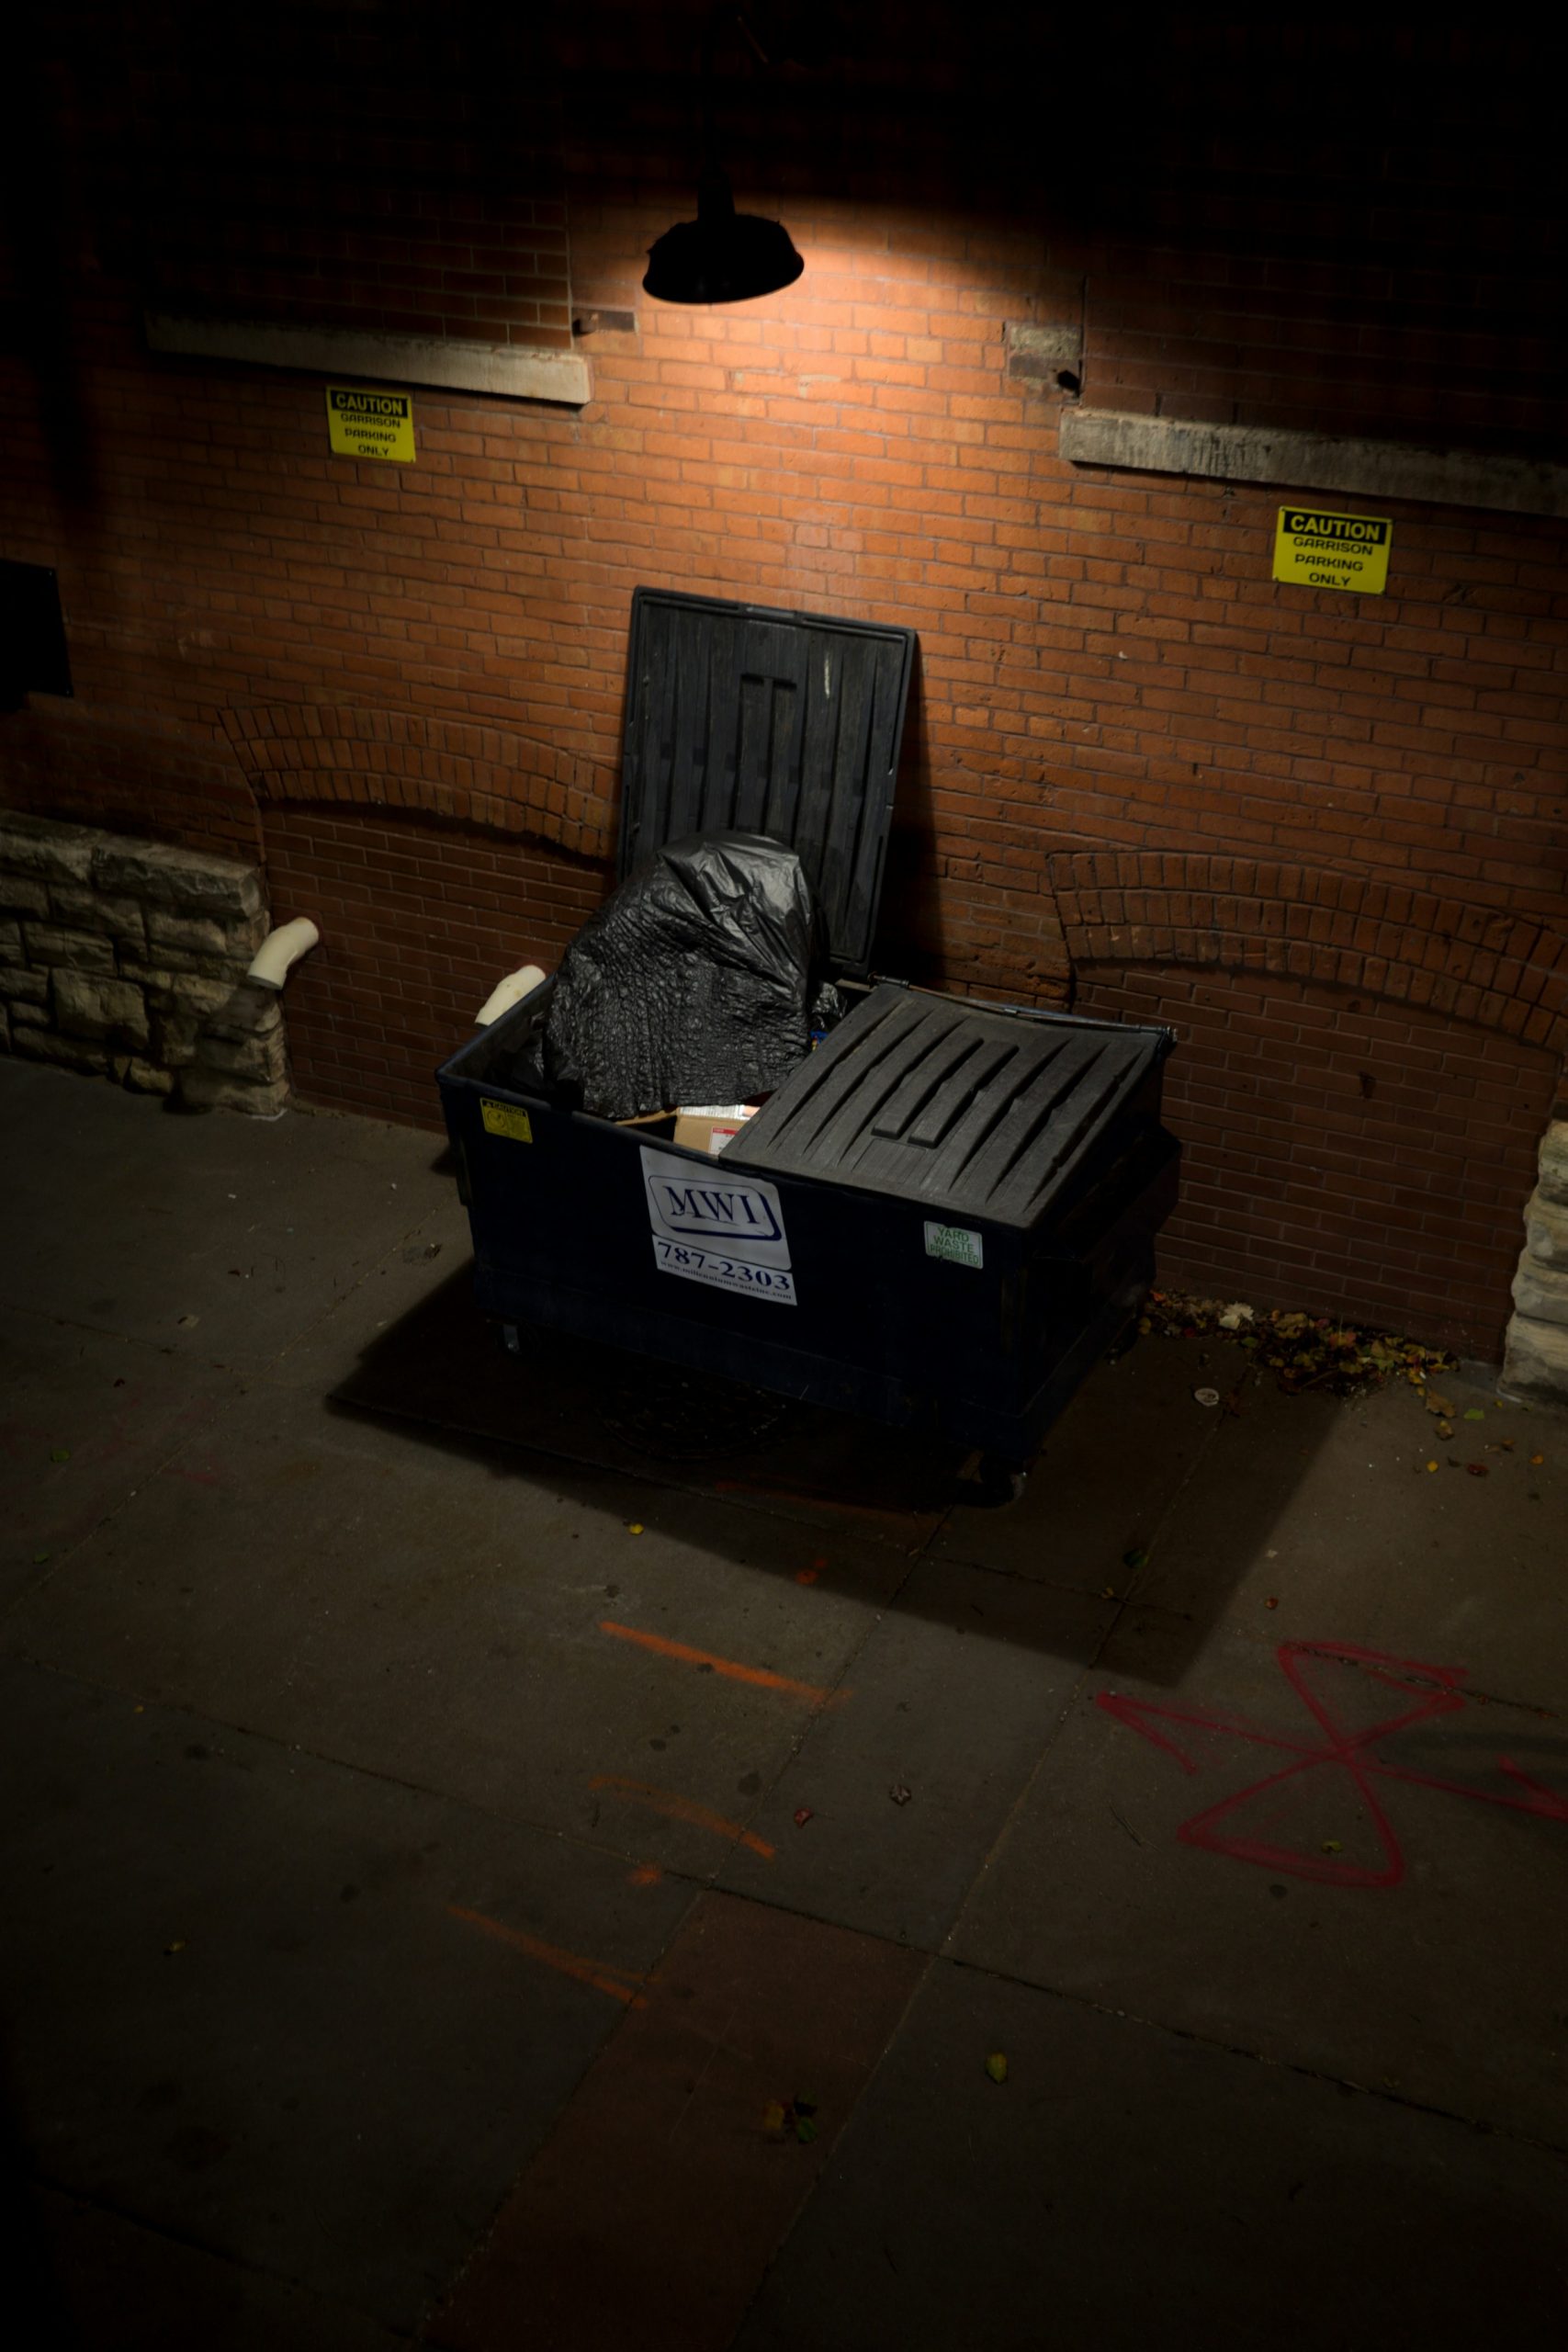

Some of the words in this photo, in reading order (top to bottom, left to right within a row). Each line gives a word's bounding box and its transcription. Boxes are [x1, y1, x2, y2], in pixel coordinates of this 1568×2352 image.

[336, 391, 402, 415] CAUTION
[341, 413, 401, 429] GARRISON
[344, 428, 396, 443] PARKING
[358, 444, 389, 457] ONLY
[1291, 514, 1380, 541] CAUTION
[1293, 537, 1373, 556] GARRISON
[1295, 553, 1363, 571] PARKING
[1309, 572, 1351, 587] ONLY
[662, 1185, 761, 1225] MWI
[937, 1227, 969, 1242] YARD
[933, 1235, 974, 1253] WASTE
[930, 1244, 979, 1265] PROHIBITED
[658, 1241, 790, 1291] 787-2303
